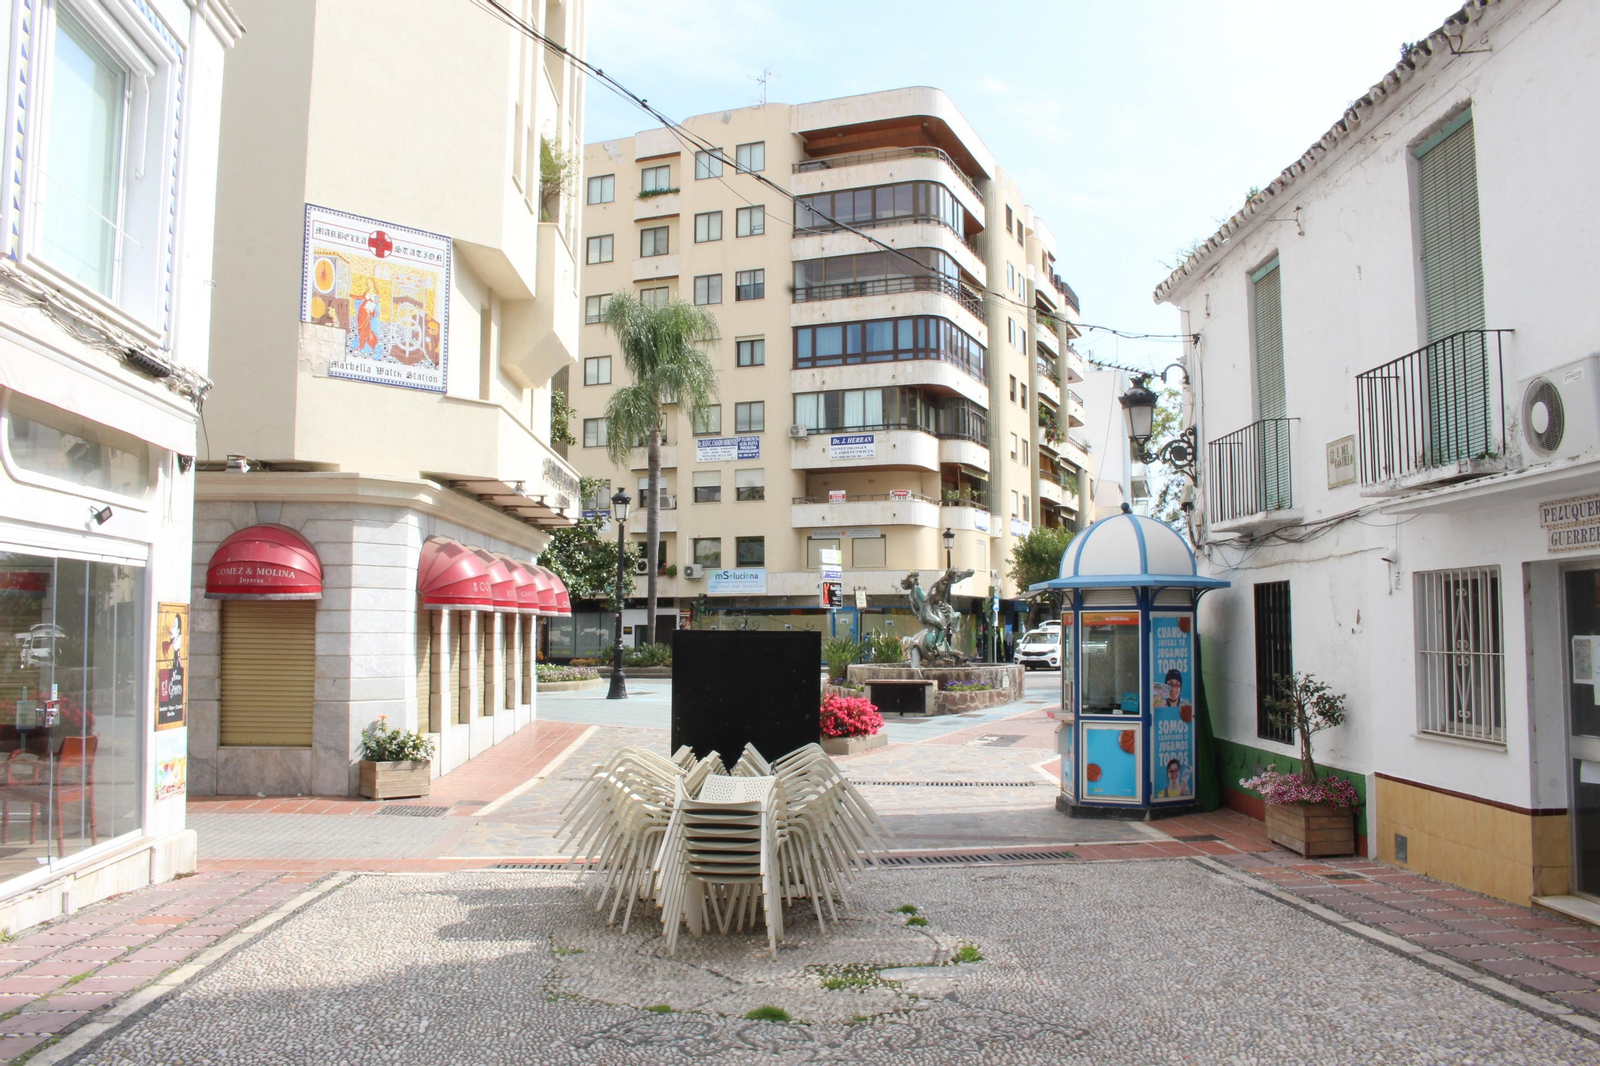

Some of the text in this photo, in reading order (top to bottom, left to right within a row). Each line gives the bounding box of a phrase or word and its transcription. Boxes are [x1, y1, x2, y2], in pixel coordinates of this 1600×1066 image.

[315, 226, 443, 262] MARBELLA STATION
[330, 360, 372, 374] Marbella
[405, 371, 438, 384] Station
[215, 566, 244, 576] GOMEZ
[256, 567, 296, 579] MOLINA
[715, 570, 759, 580] mSoluciona
[1157, 647, 1188, 659] JUGAMOS
[1158, 658, 1188, 674] TODOS
[1158, 719, 1189, 735] SOMOS
[1159, 740, 1189, 752] JUGAMOS
